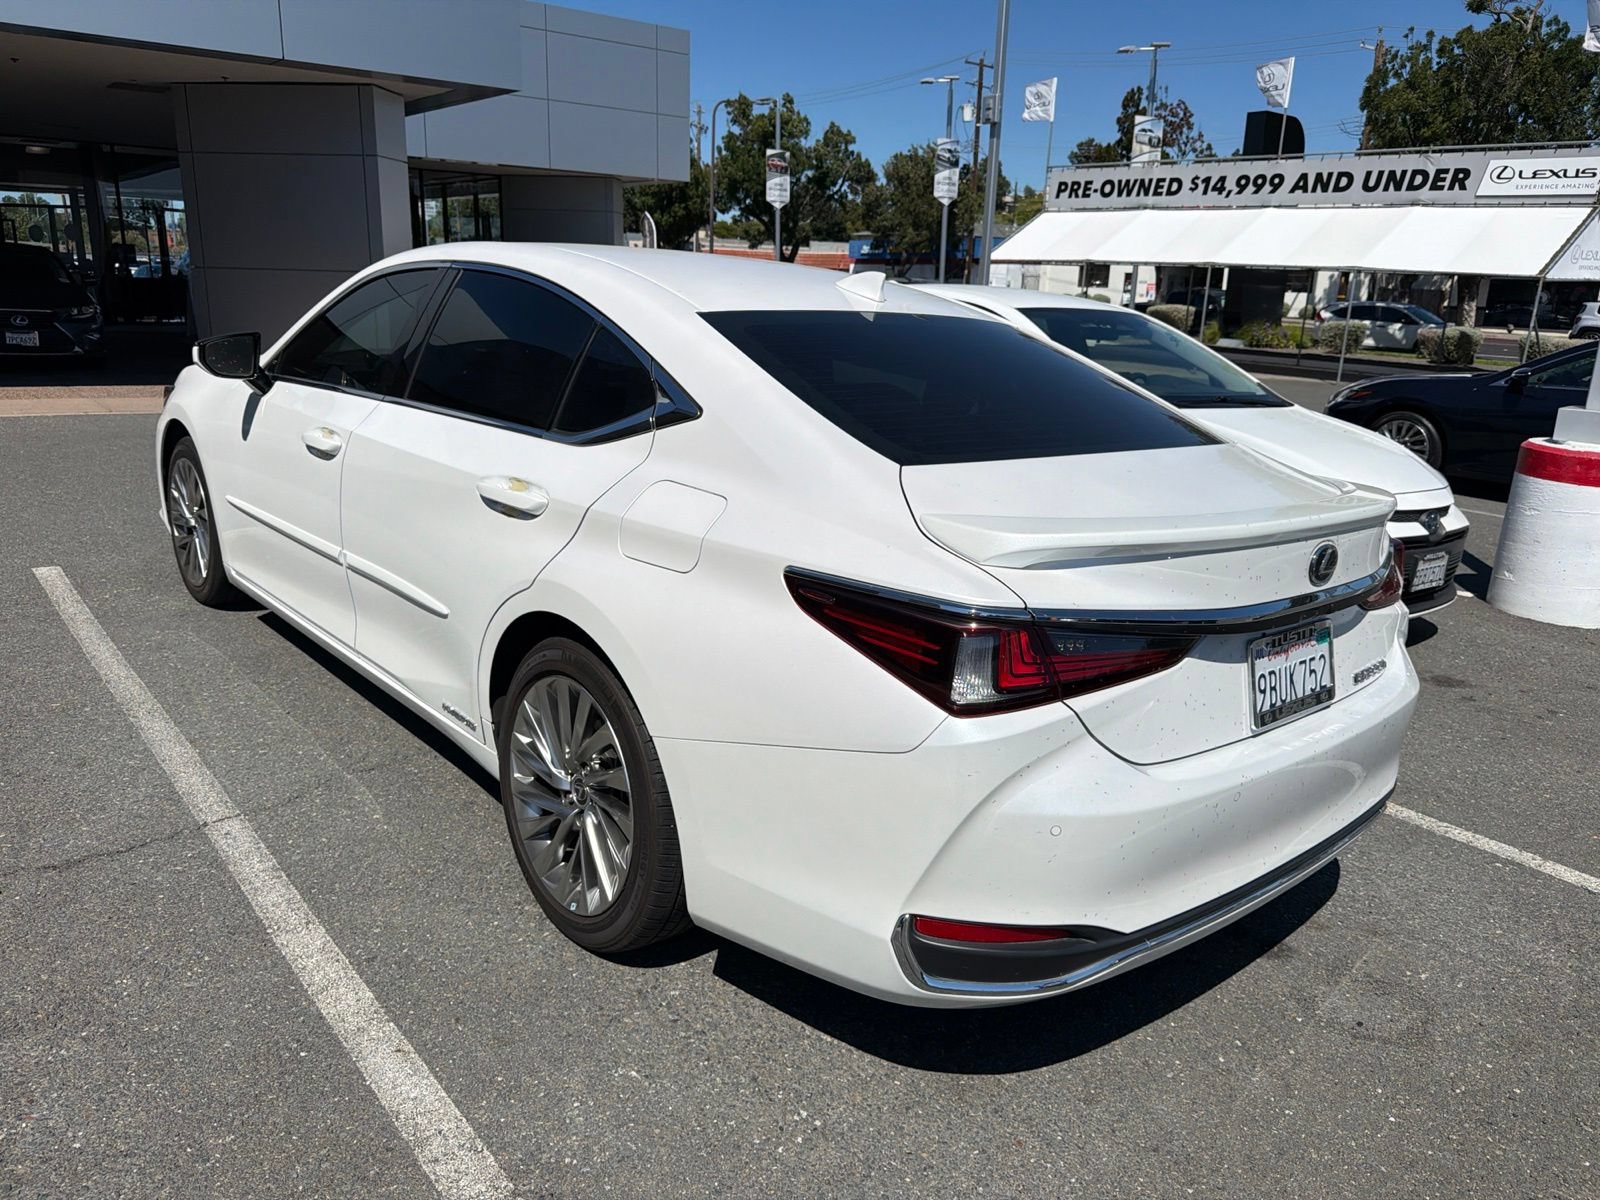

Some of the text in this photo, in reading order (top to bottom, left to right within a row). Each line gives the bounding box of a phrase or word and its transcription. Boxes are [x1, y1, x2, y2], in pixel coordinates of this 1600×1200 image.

[1055, 168, 1471, 199] PRE-OWNED $14,999 AND UNDER
[1518, 167, 1598, 180] LEXUS
[1257, 653, 1328, 715] 9BUK752
